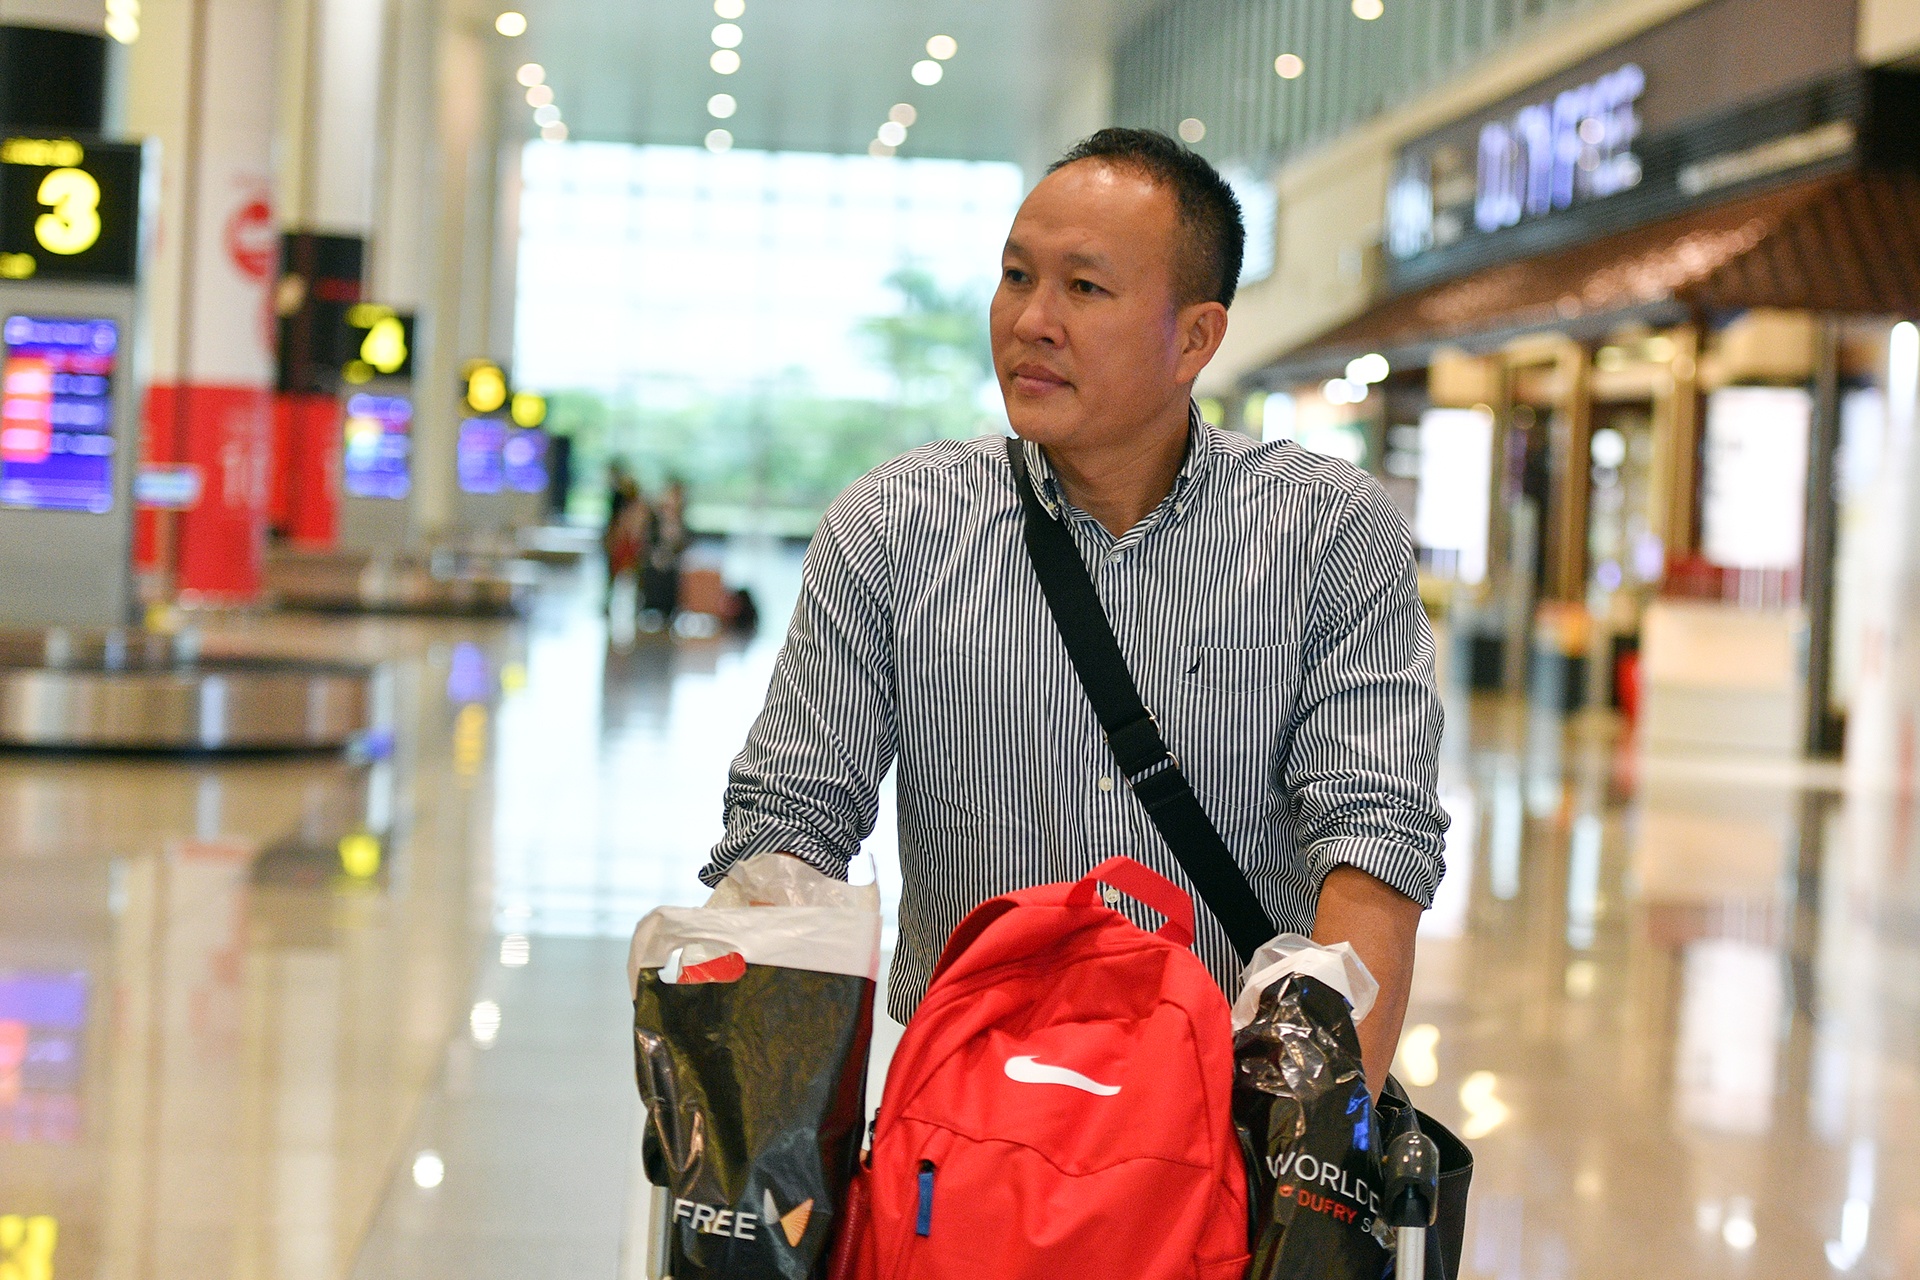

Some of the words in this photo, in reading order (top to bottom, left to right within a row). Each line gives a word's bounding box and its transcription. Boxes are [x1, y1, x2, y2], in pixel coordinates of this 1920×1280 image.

[35, 167, 101, 255] 3
[360, 317, 408, 374] 4
[673, 1198, 758, 1241] FREE
[1298, 1188, 1358, 1225] DUFRY
